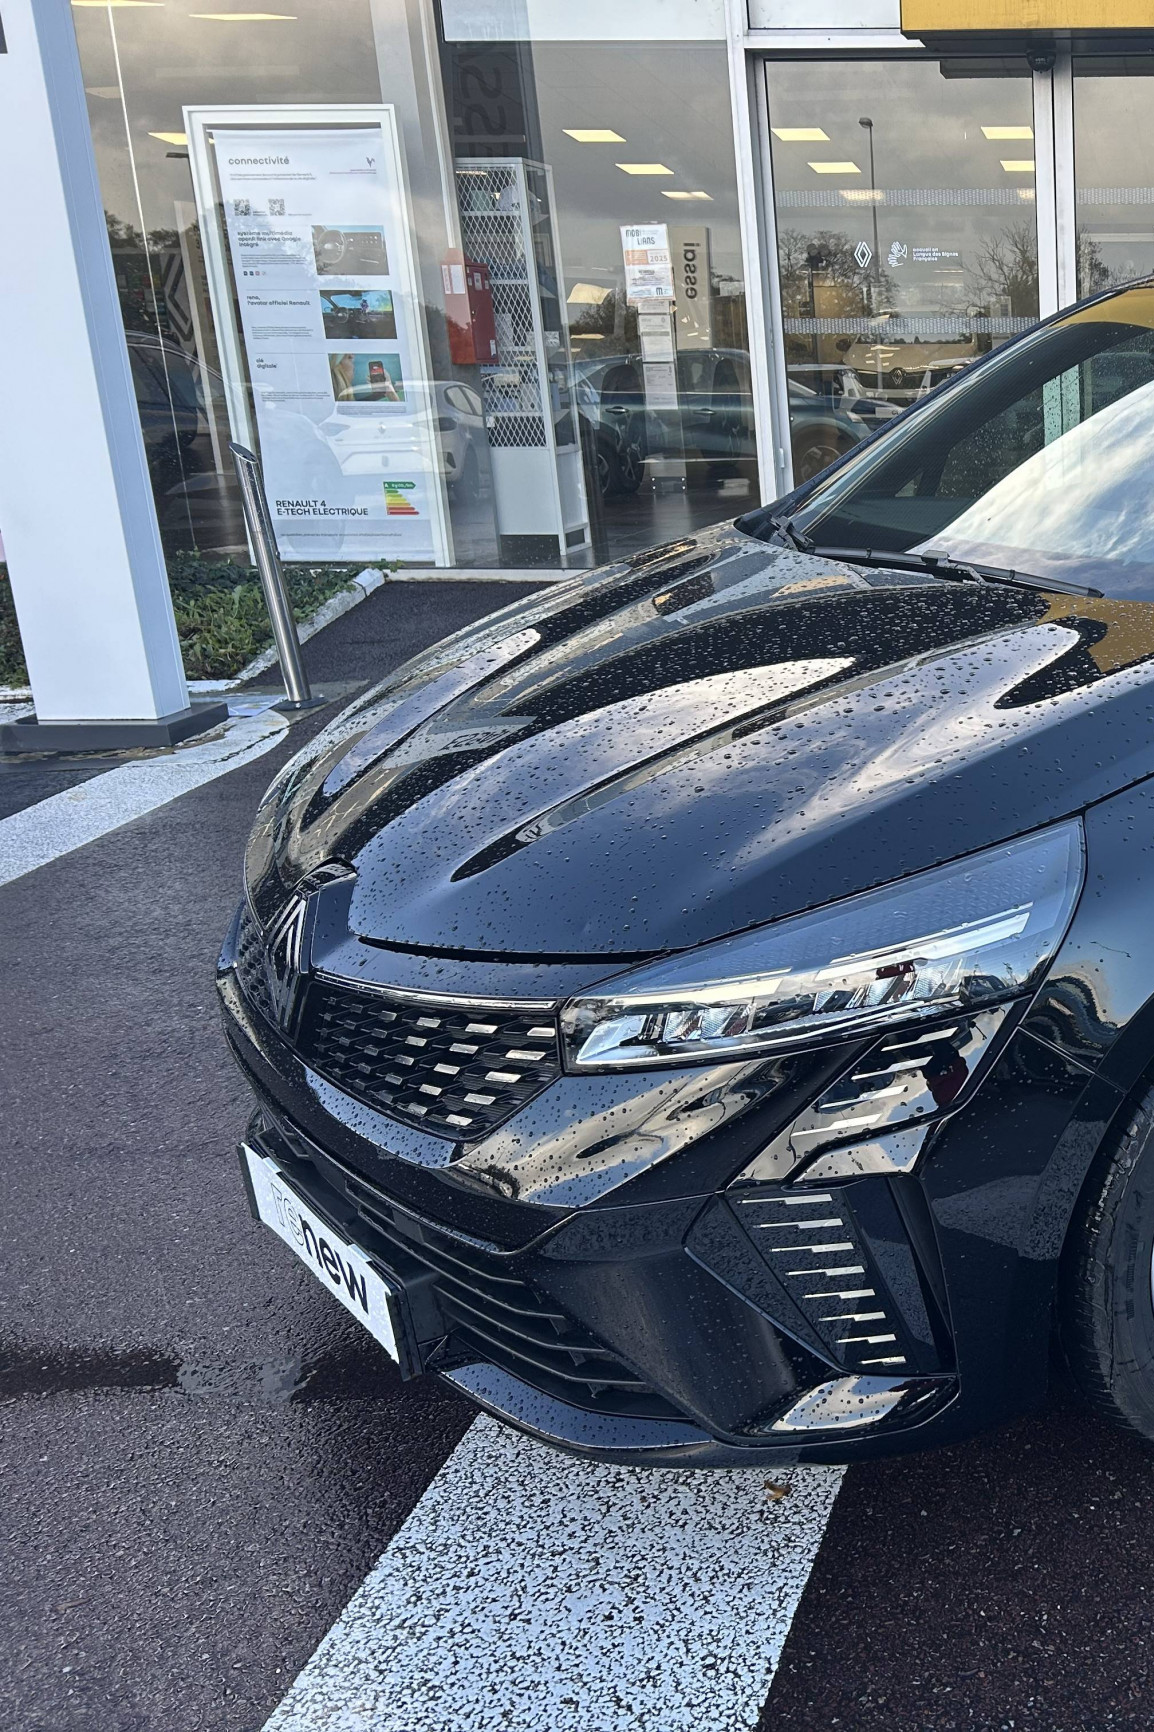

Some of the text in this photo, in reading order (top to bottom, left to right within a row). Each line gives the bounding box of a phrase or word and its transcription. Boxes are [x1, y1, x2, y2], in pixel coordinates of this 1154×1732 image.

[228, 156, 290, 165] connectivité
[275, 500, 319, 508] RENAULT
[277, 508, 369, 516] E-TECH ELECTRIQUE
